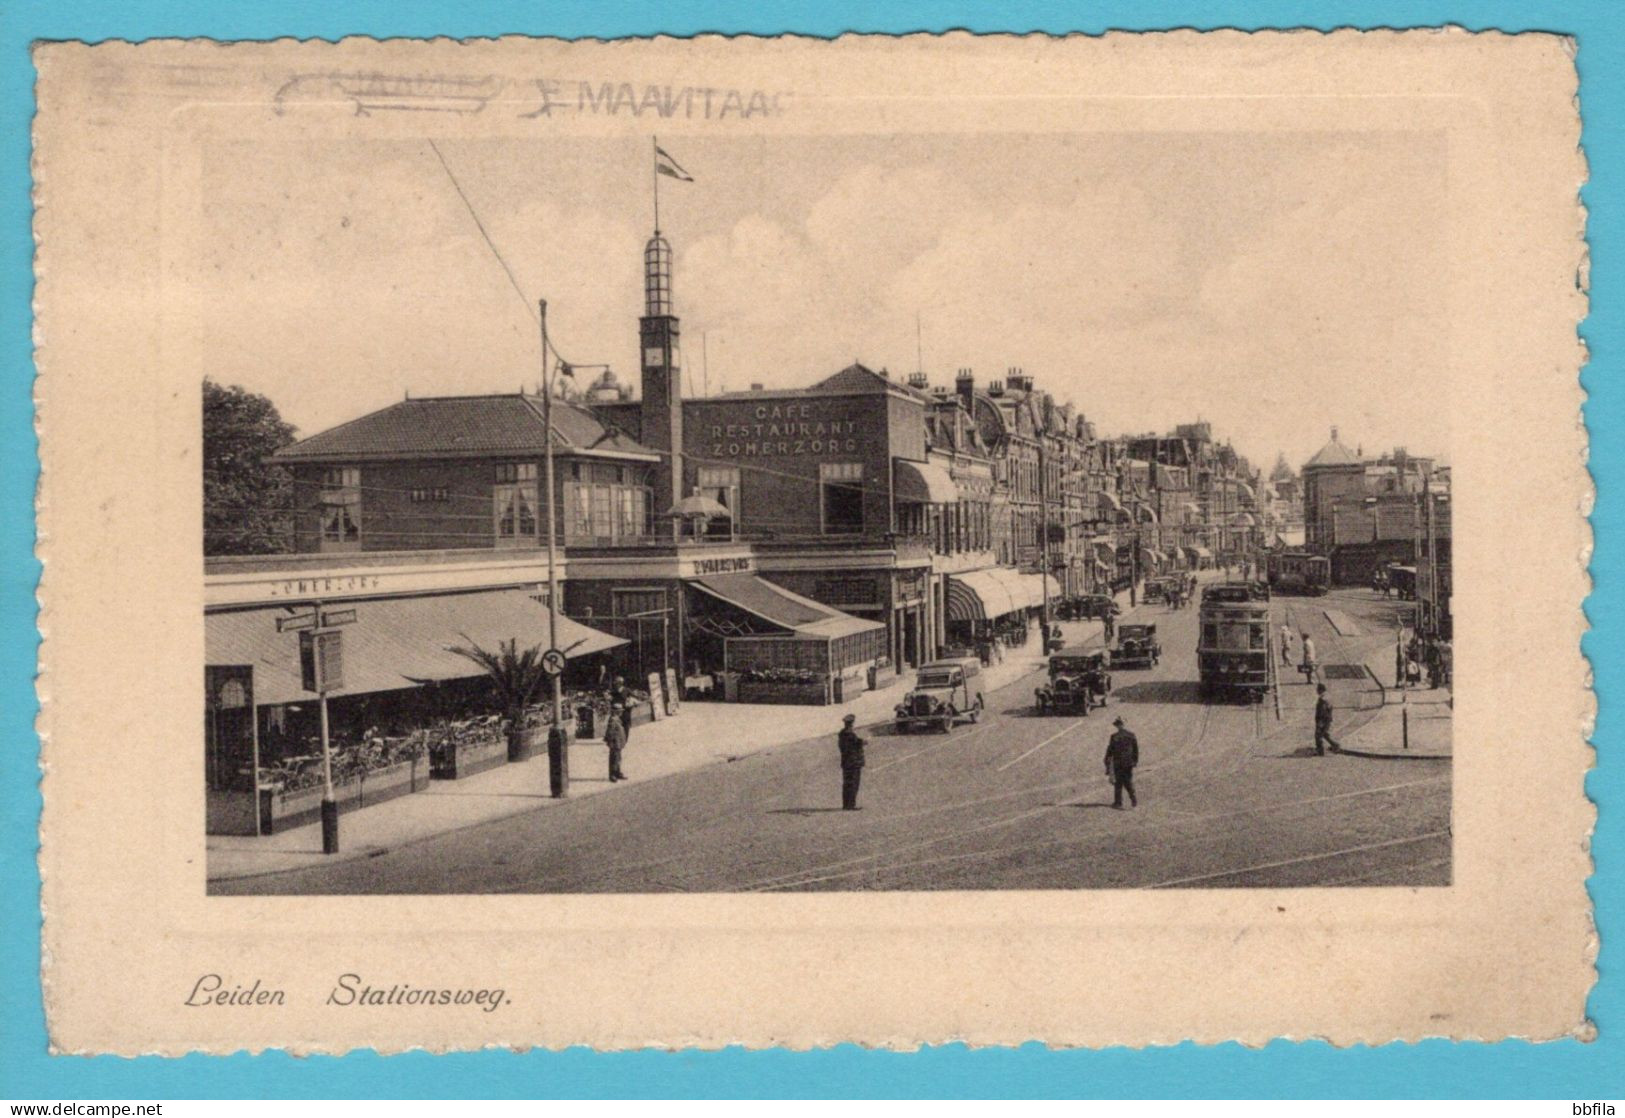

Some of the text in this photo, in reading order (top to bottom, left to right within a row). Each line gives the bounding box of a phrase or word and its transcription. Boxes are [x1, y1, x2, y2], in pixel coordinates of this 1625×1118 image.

[711, 421, 855, 438] RESTAURANT
[713, 440, 855, 456] ZOMERZORG
[184, 973, 512, 1013] Leiden Stationsweg.
